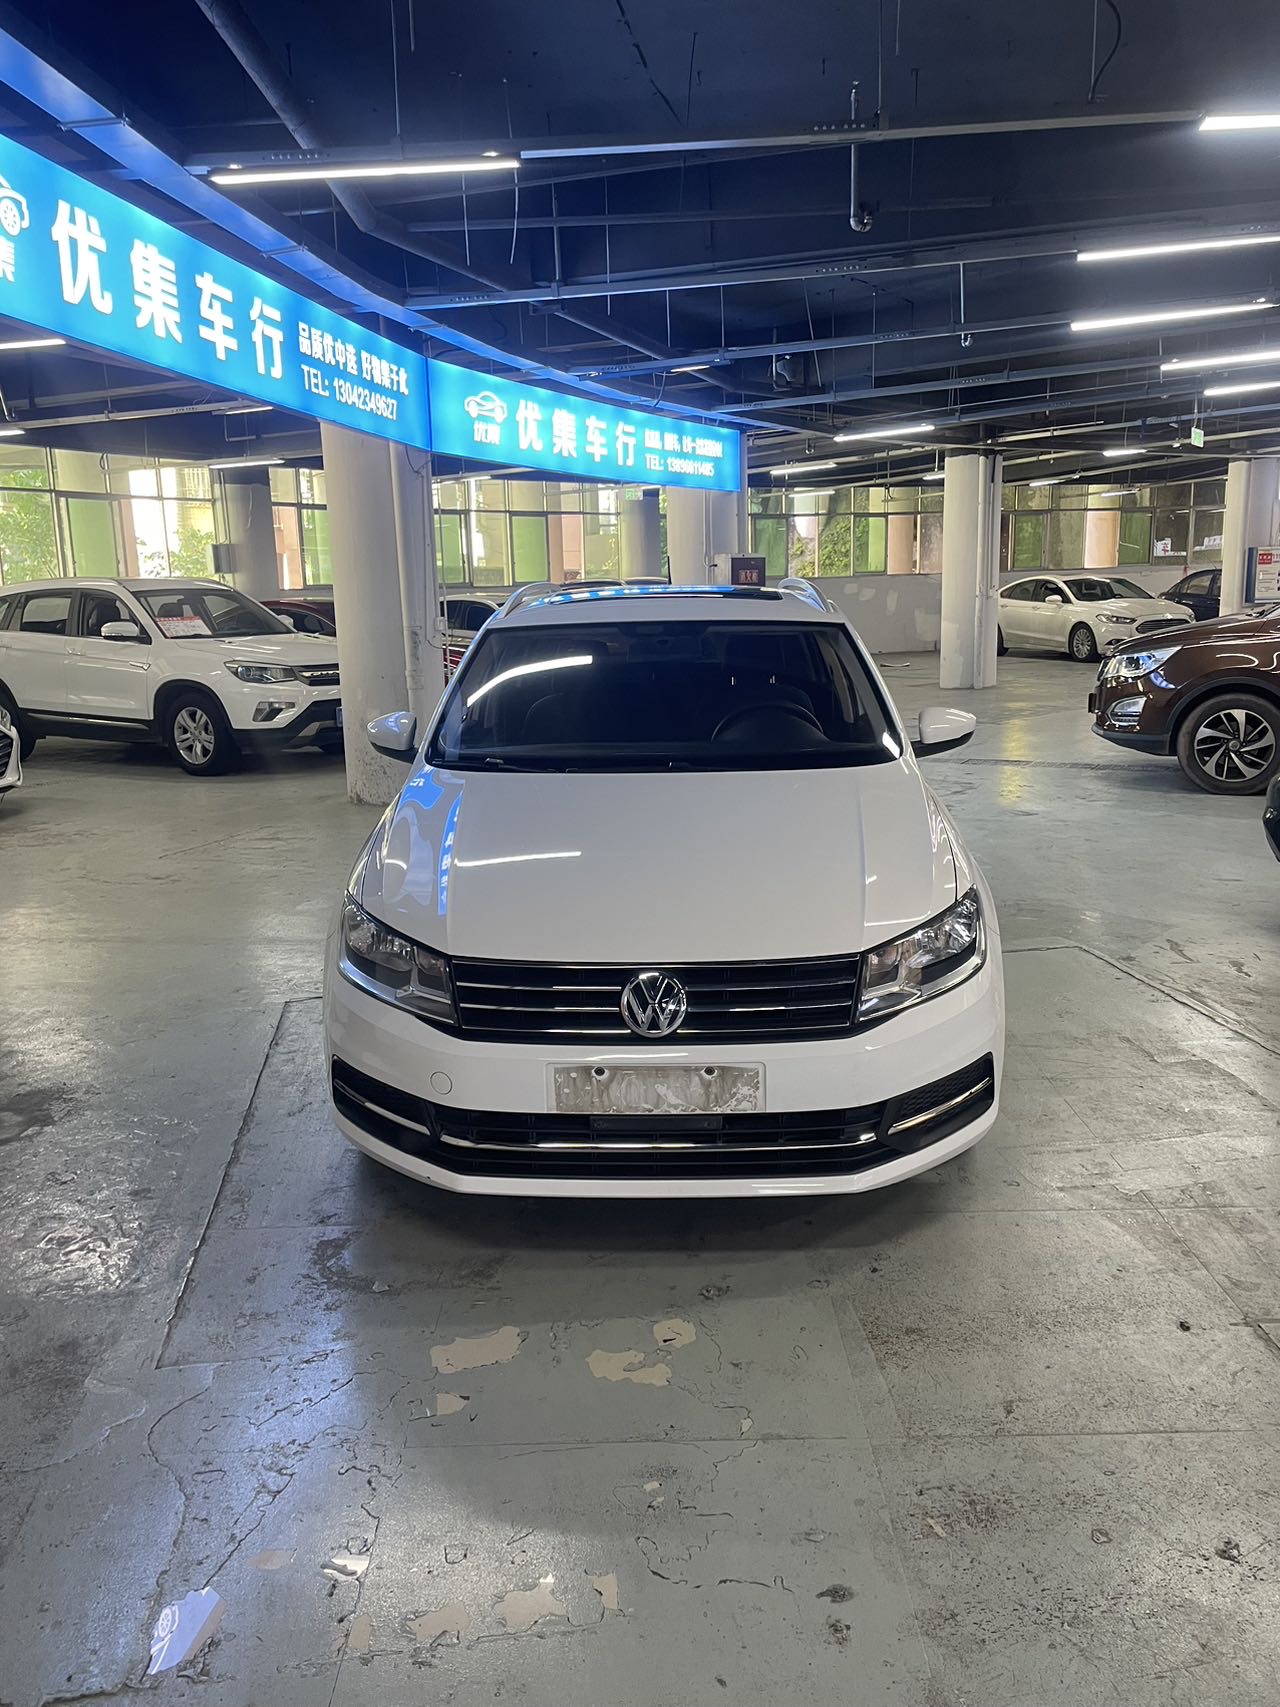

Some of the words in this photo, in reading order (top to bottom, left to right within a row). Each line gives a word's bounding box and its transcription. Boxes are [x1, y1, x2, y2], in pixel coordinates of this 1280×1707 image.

[50, 200, 285, 379] 优集车行
[299, 321, 358, 375] 品质优中选
[301, 363, 330, 396] TEL:
[333, 377, 397, 421] 13042349627
[515, 399, 637, 466] 优集车行
[645, 453, 664, 471] TEL:
